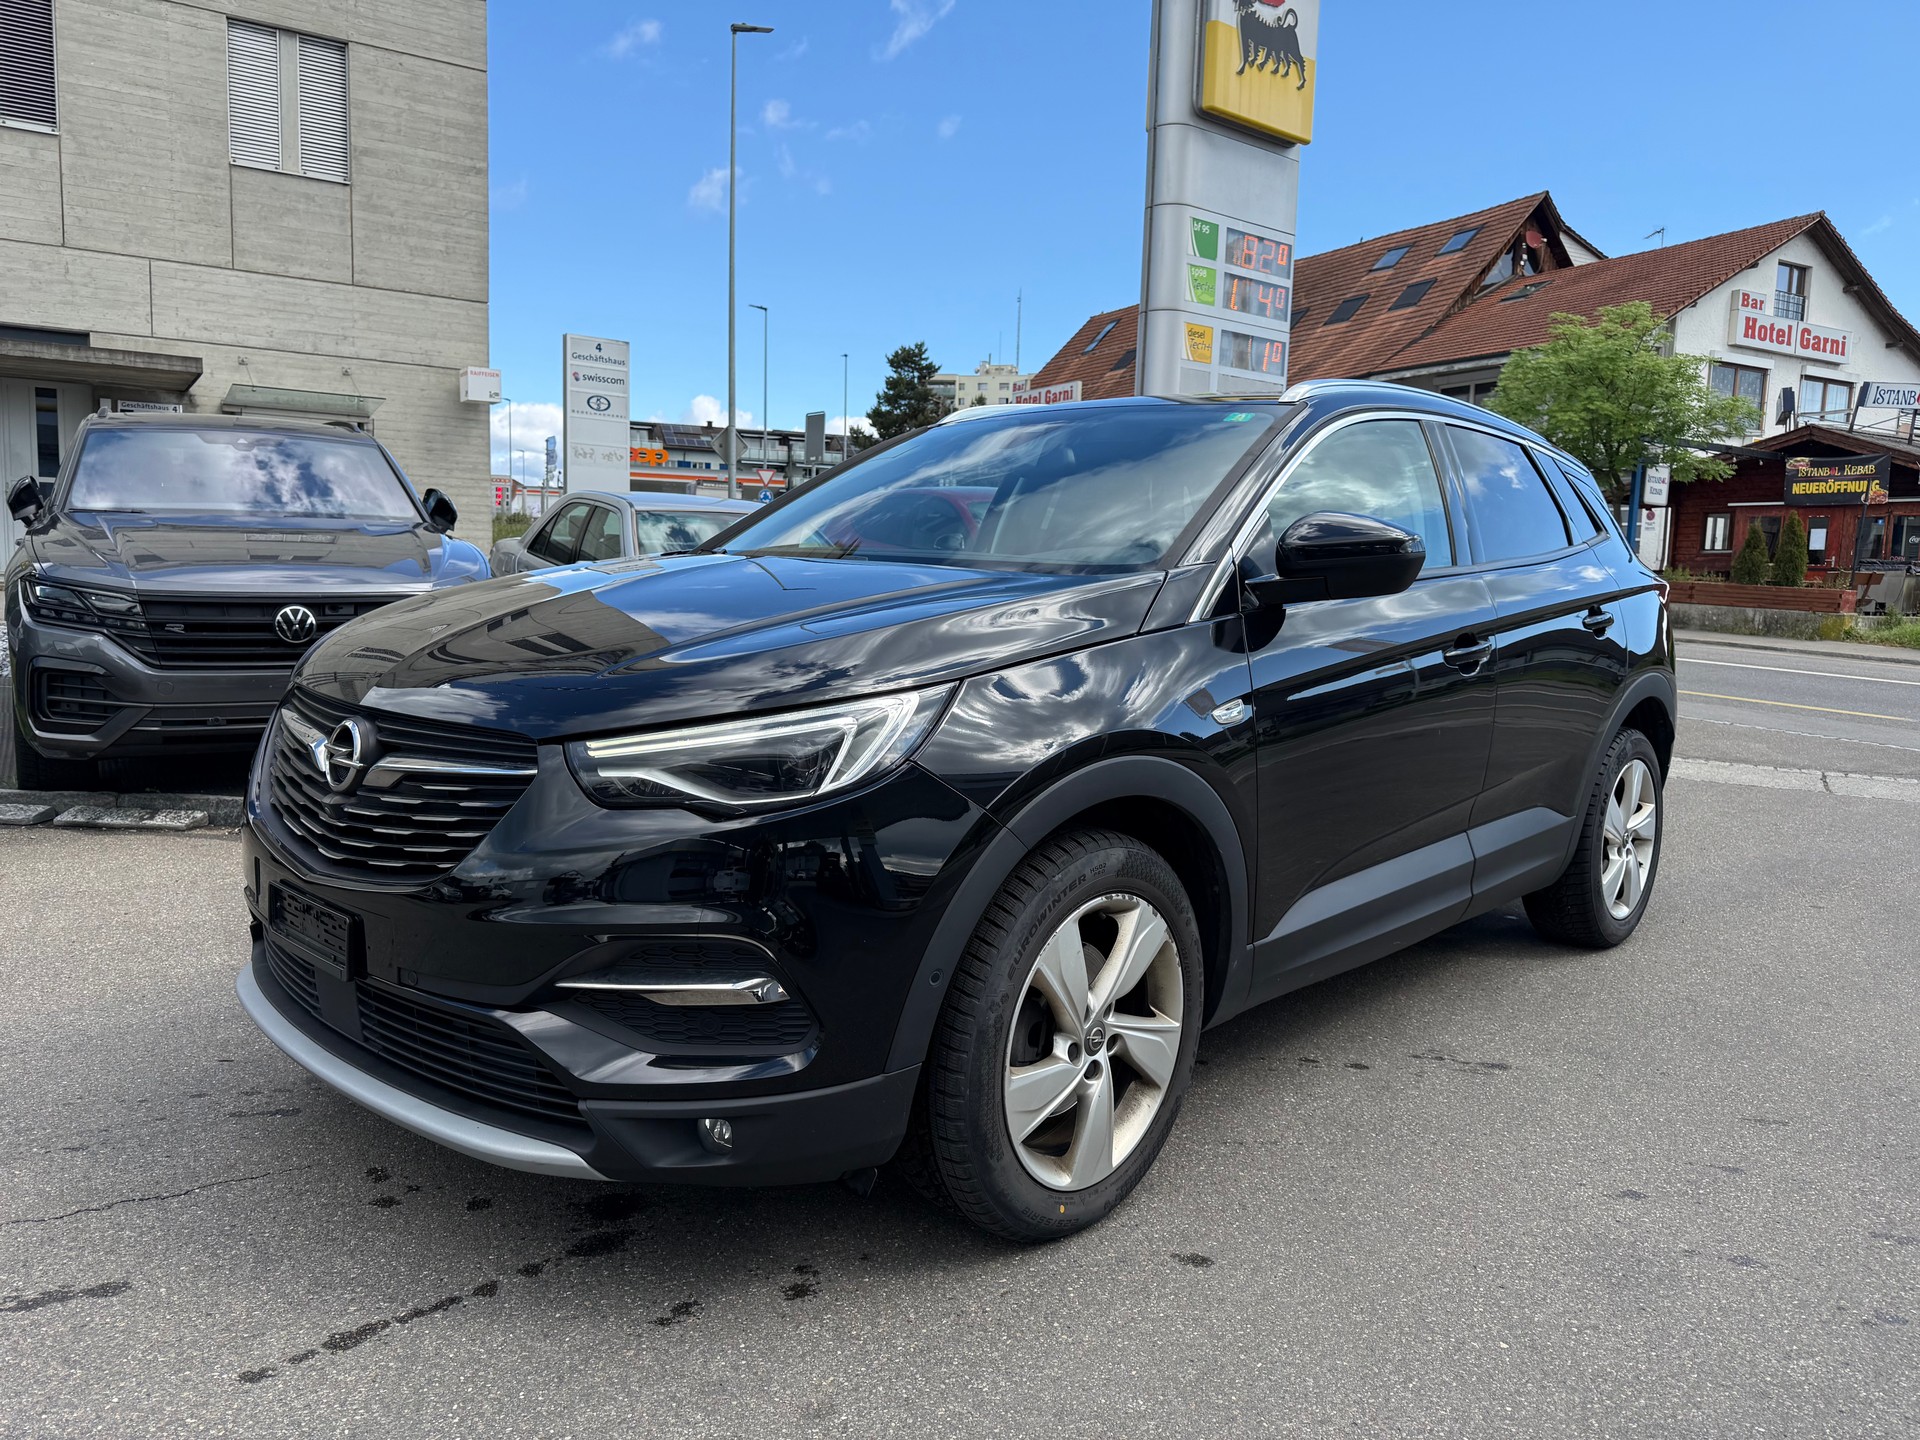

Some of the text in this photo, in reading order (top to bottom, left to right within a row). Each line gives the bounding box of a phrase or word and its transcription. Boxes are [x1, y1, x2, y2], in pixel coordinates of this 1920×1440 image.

[1201, 225, 1210, 234] 95
[1191, 267, 1207, 278] sp98
[1741, 292, 1764, 311] Bar
[1187, 328, 1205, 340] diesel
[1743, 316, 1847, 357] Hotel Garni
[595, 343, 602, 353] 4
[571, 352, 626, 366] Geschäftshaus
[582, 373, 625, 385] swisscom
[1012, 382, 1025, 393] Bar
[1015, 385, 1074, 405] Hotel Garni
[121, 402, 170, 411] Geschäftshaus
[630, 447, 669, 467] oop
[1844, 464, 1876, 476] KEBAB
[1007, 873, 1088, 981] EUROWINTER
